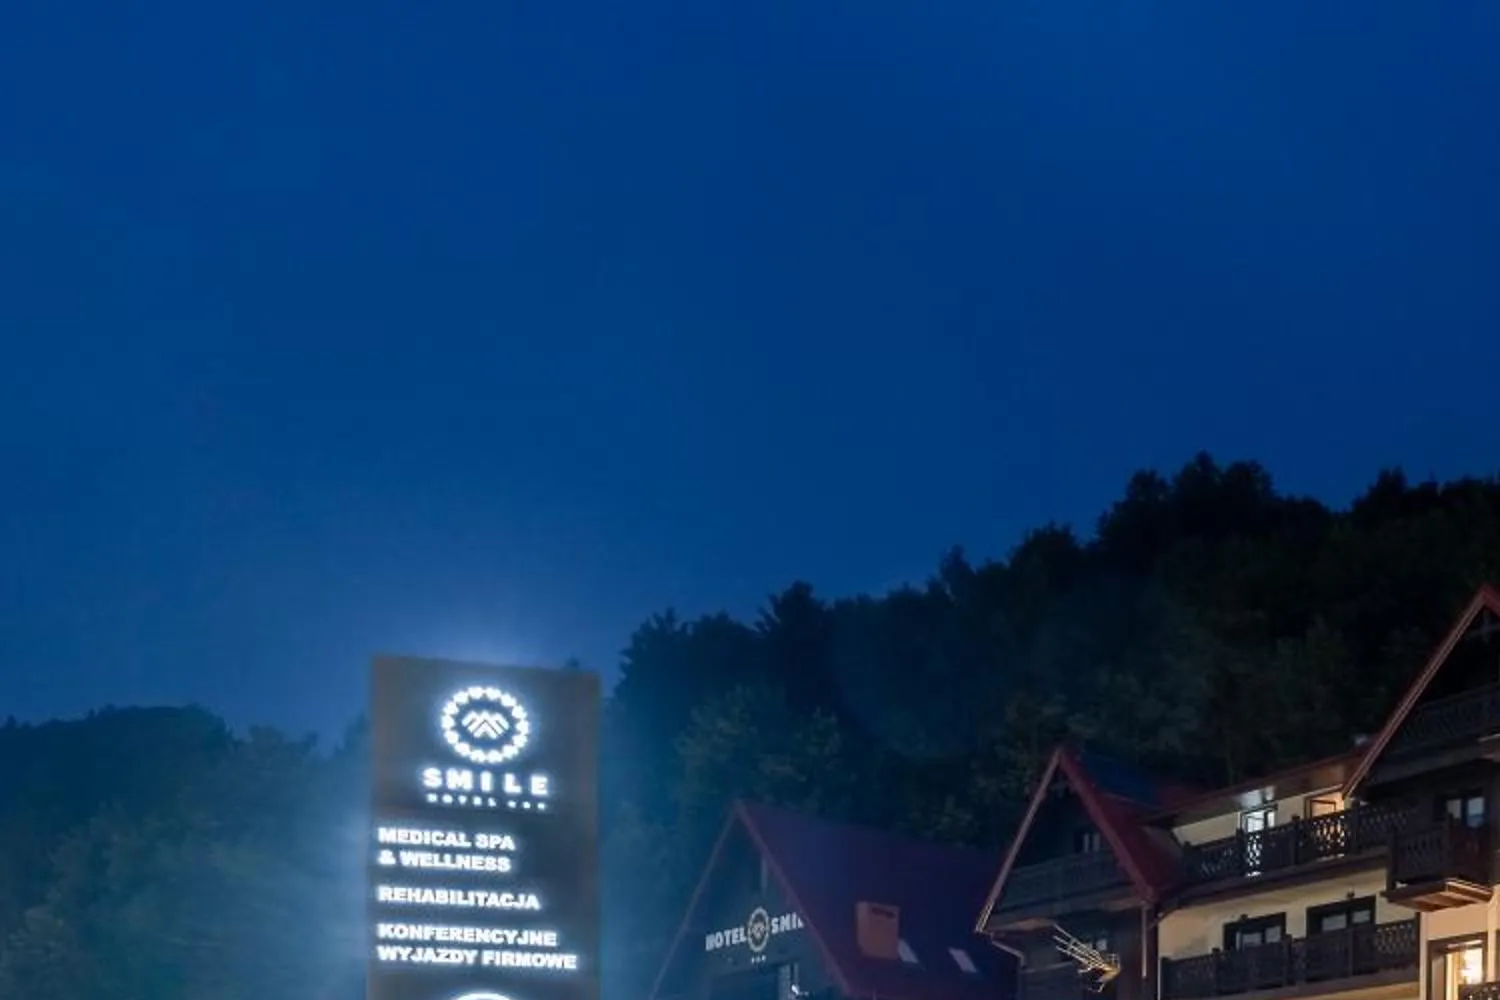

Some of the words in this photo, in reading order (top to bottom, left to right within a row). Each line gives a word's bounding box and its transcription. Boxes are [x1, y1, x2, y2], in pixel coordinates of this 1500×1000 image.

[422, 767, 549, 796] SMILE
[376, 827, 471, 848] MEDICAL
[475, 833, 516, 851] SPA
[377, 849, 396, 866] &
[400, 851, 511, 873] WELLNESS
[377, 885, 541, 910] REHABILITACJA
[377, 923, 557, 947] KONFERENCYJNE
[705, 926, 746, 951] HOTEL
[377, 945, 478, 965] WYJAZDY
[481, 950, 577, 969] FIRMOWE
